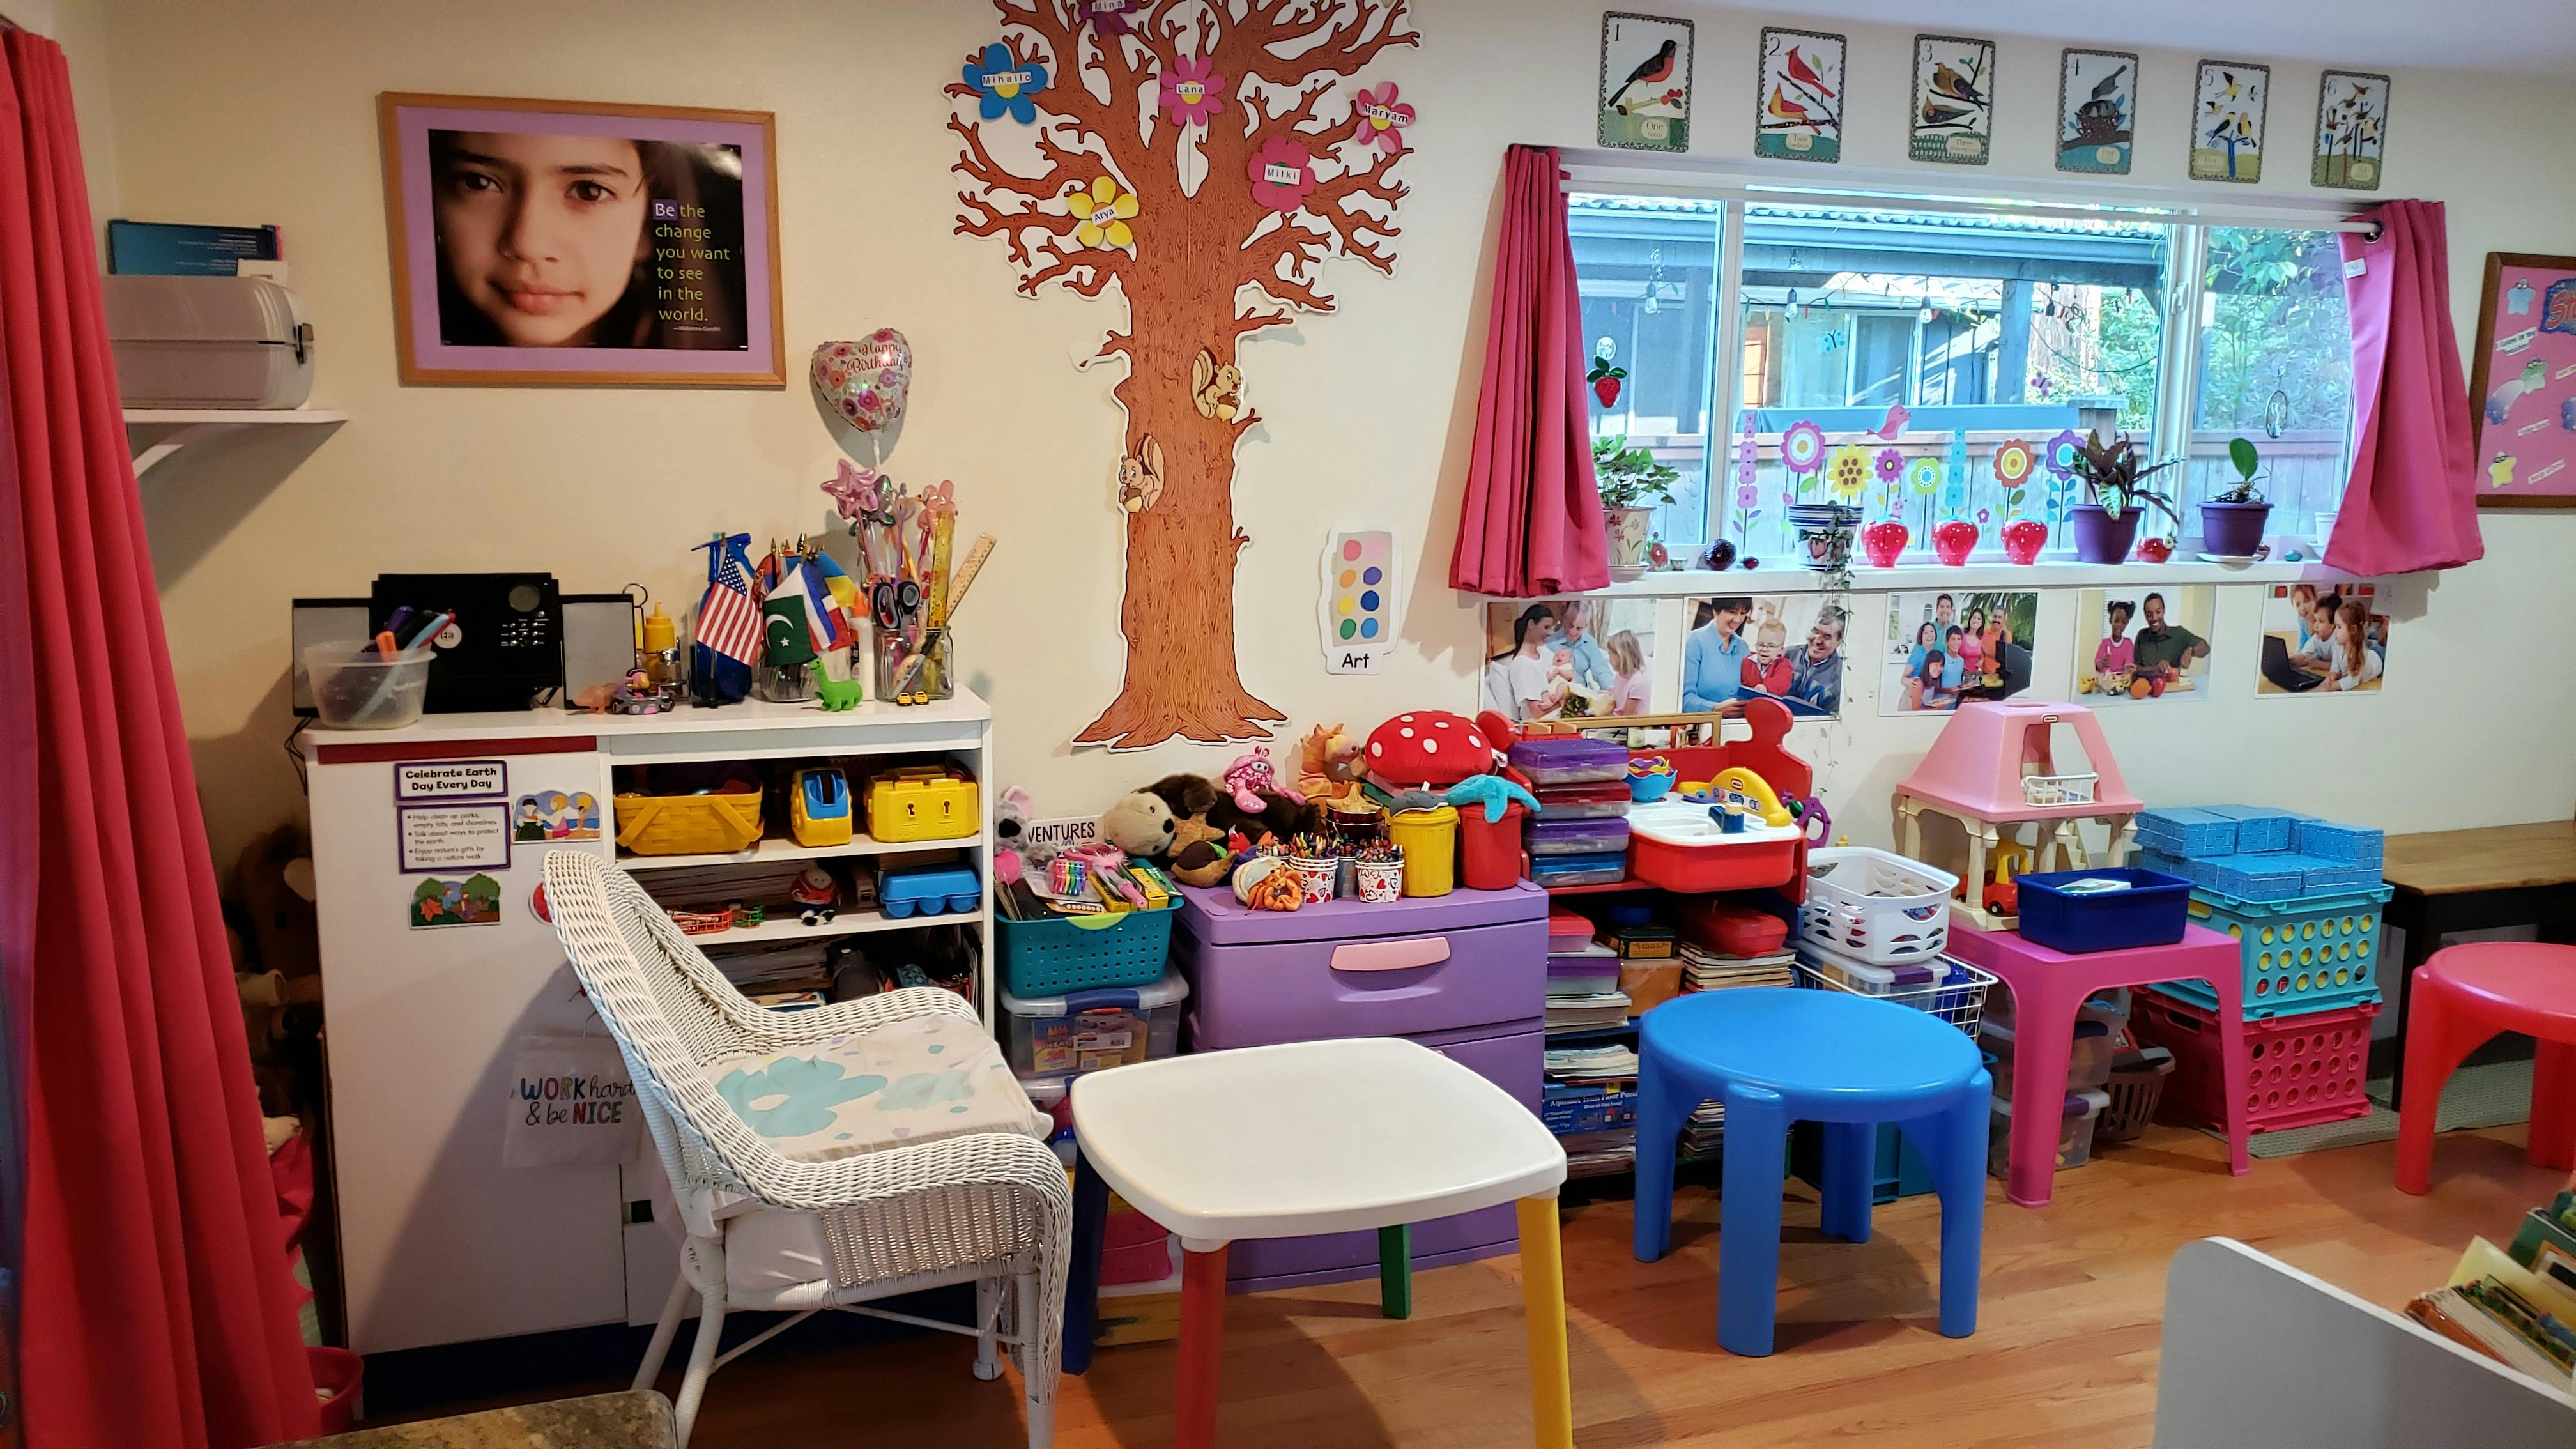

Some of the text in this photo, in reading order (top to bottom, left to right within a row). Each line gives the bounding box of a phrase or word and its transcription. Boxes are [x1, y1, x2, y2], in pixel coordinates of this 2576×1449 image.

[1094, 1, 1123, 10] Mina
[1614, 24, 1620, 41] 1
[1769, 37, 1781, 56] 2
[1922, 43, 1933, 62] 3
[2070, 58, 2080, 75] 4
[983, 74, 1031, 84] Mihailo
[2204, 69, 2214, 86] 5
[2327, 79, 2336, 95] 6
[1364, 104, 1408, 123] Maryam
[1267, 168, 1296, 180] Milki
[656, 203, 705, 218] Be the
[1094, 208, 1114, 222] Arya
[656, 224, 712, 242] change
[656, 247, 731, 262] you want
[657, 266, 703, 280] to see
[658, 286, 703, 300] in the
[659, 307, 709, 321] world.
[859, 342, 902, 356] Happy
[1342, 653, 1369, 668] Art
[406, 767, 497, 779] Celebrate Earth
[412, 779, 492, 791] Day Every Day
[521, 1075, 637, 1100] WORK hard
[526, 1100, 623, 1126] & be NICE
